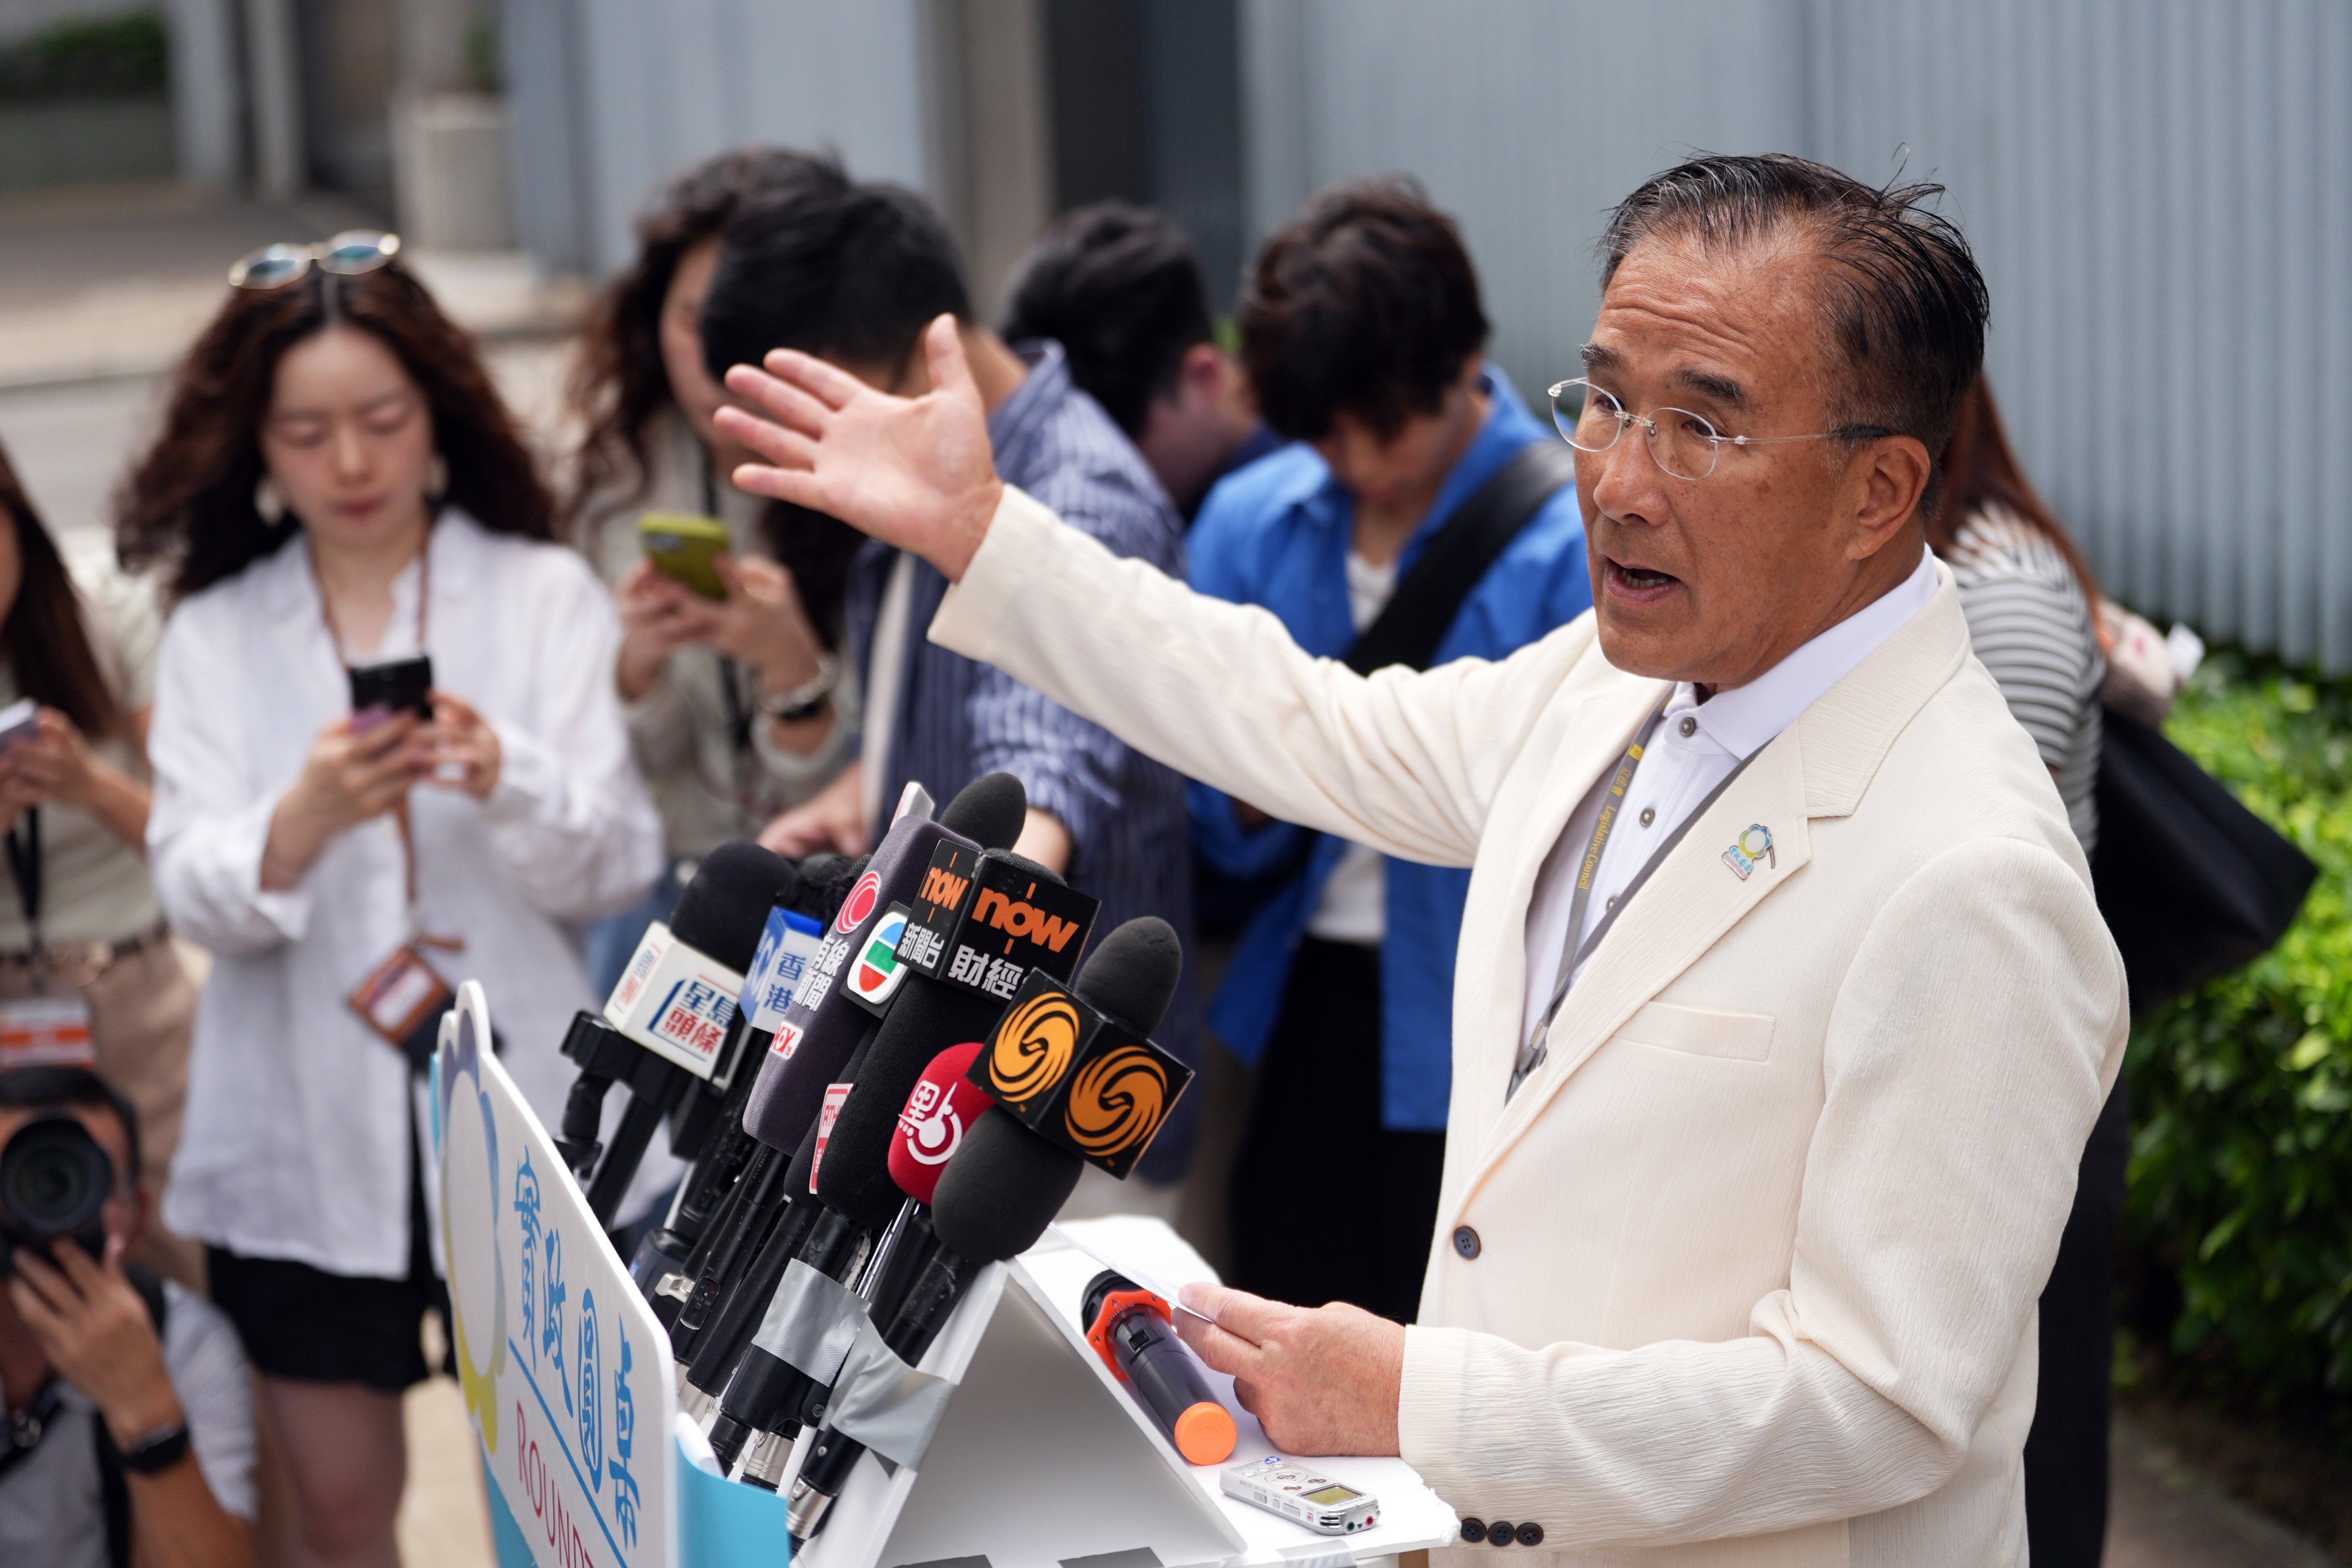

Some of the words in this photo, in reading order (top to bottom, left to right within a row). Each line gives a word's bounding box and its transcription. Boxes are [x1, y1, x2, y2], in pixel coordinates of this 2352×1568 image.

[1590, 805, 1617, 853] Legislative
[920, 867, 969, 911] now
[1578, 854, 1598, 890] Council
[971, 887, 1080, 953] now
[812, 934, 850, 976] 有線
[897, 921, 945, 970] 新聞台
[763, 951, 807, 1015] 香港
[792, 968, 833, 1012] 新聞
[948, 944, 1028, 1001] 財經
[678, 980, 737, 1028] 星島
[661, 1006, 723, 1055] 頭條
[822, 1105, 842, 1127] RTH
[516, 1399, 595, 1568] ROUND
